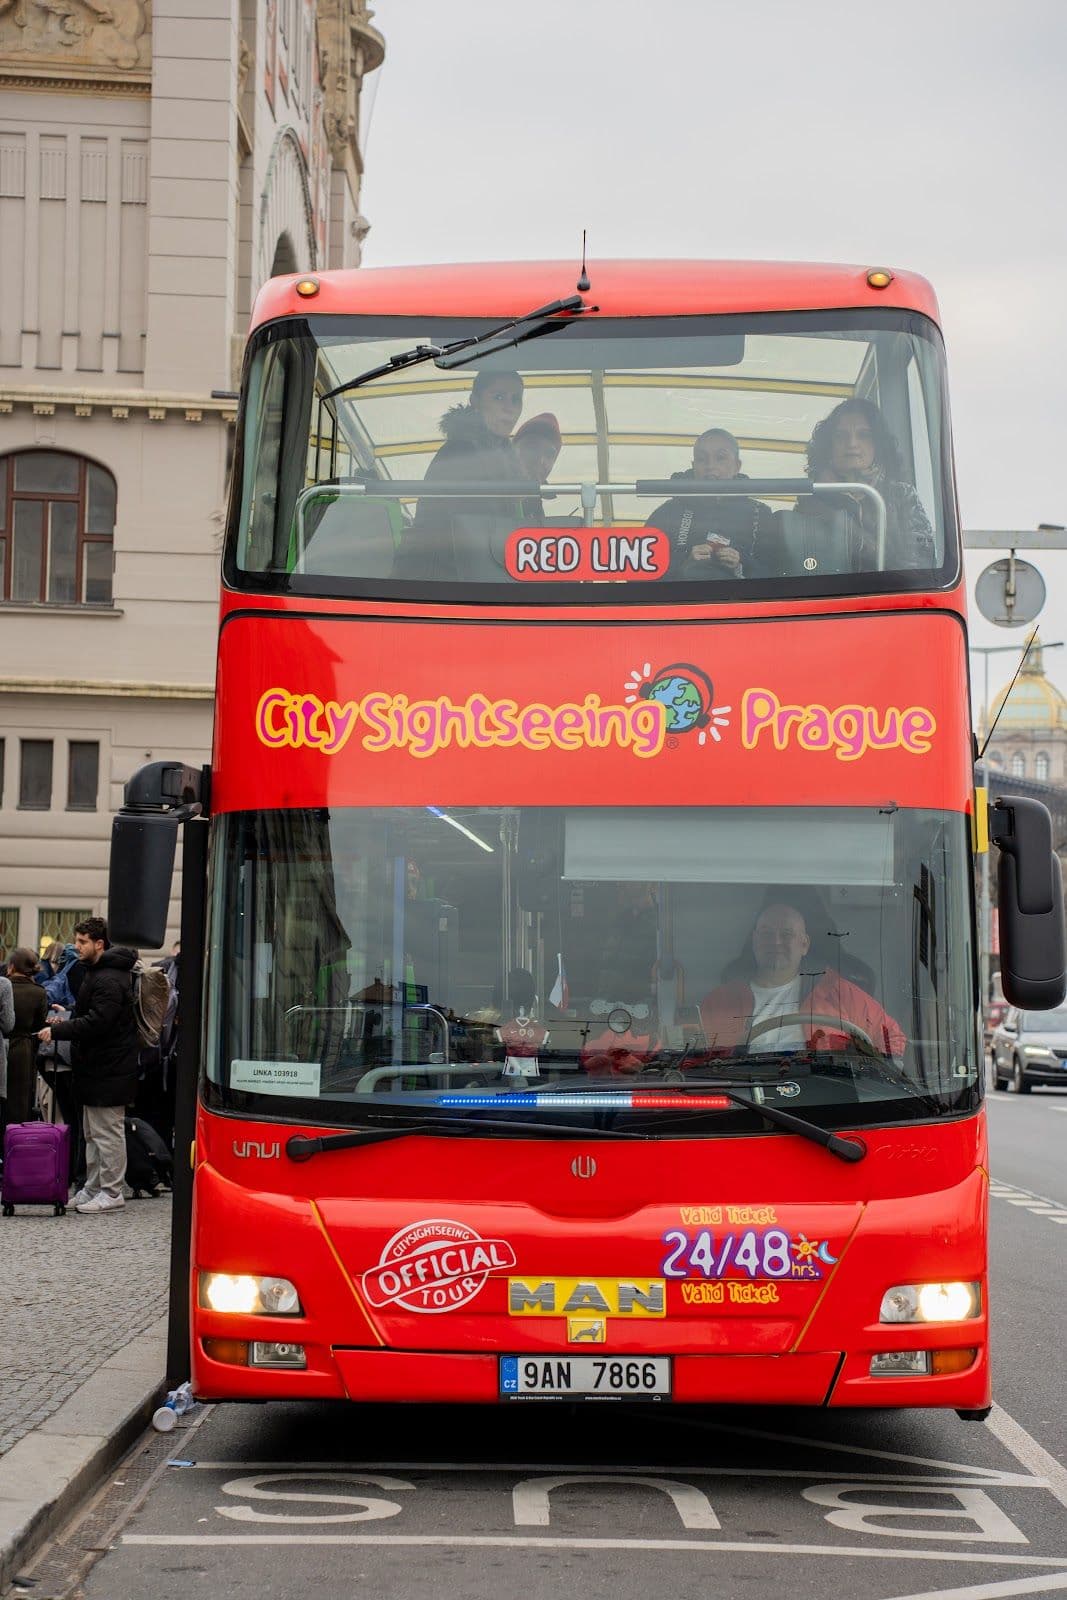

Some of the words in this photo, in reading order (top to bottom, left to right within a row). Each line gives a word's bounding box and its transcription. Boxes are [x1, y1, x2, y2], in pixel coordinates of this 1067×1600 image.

[517, 536, 581, 572] RED
[592, 536, 659, 572] LINE
[742, 687, 936, 761] Prague
[680, 1206, 722, 1225] Valid
[726, 1206, 777, 1225] Ticket
[392, 1225, 470, 1257] CITYSIGHTSEEING
[663, 1230, 791, 1277] 24/48
[791, 1261, 820, 1277] hrs.
[378, 1243, 507, 1296] OFFICIAL
[421, 1277, 479, 1306] TOUR
[510, 1281, 664, 1313] MAN
[681, 1283, 724, 1304] Valid
[727, 1282, 779, 1304] Ticket
[504, 1379, 517, 1389] CZ
[524, 1362, 572, 1389] 9AN
[592, 1362, 657, 1389] 7866
[213, 1473, 1030, 1545] BUS
